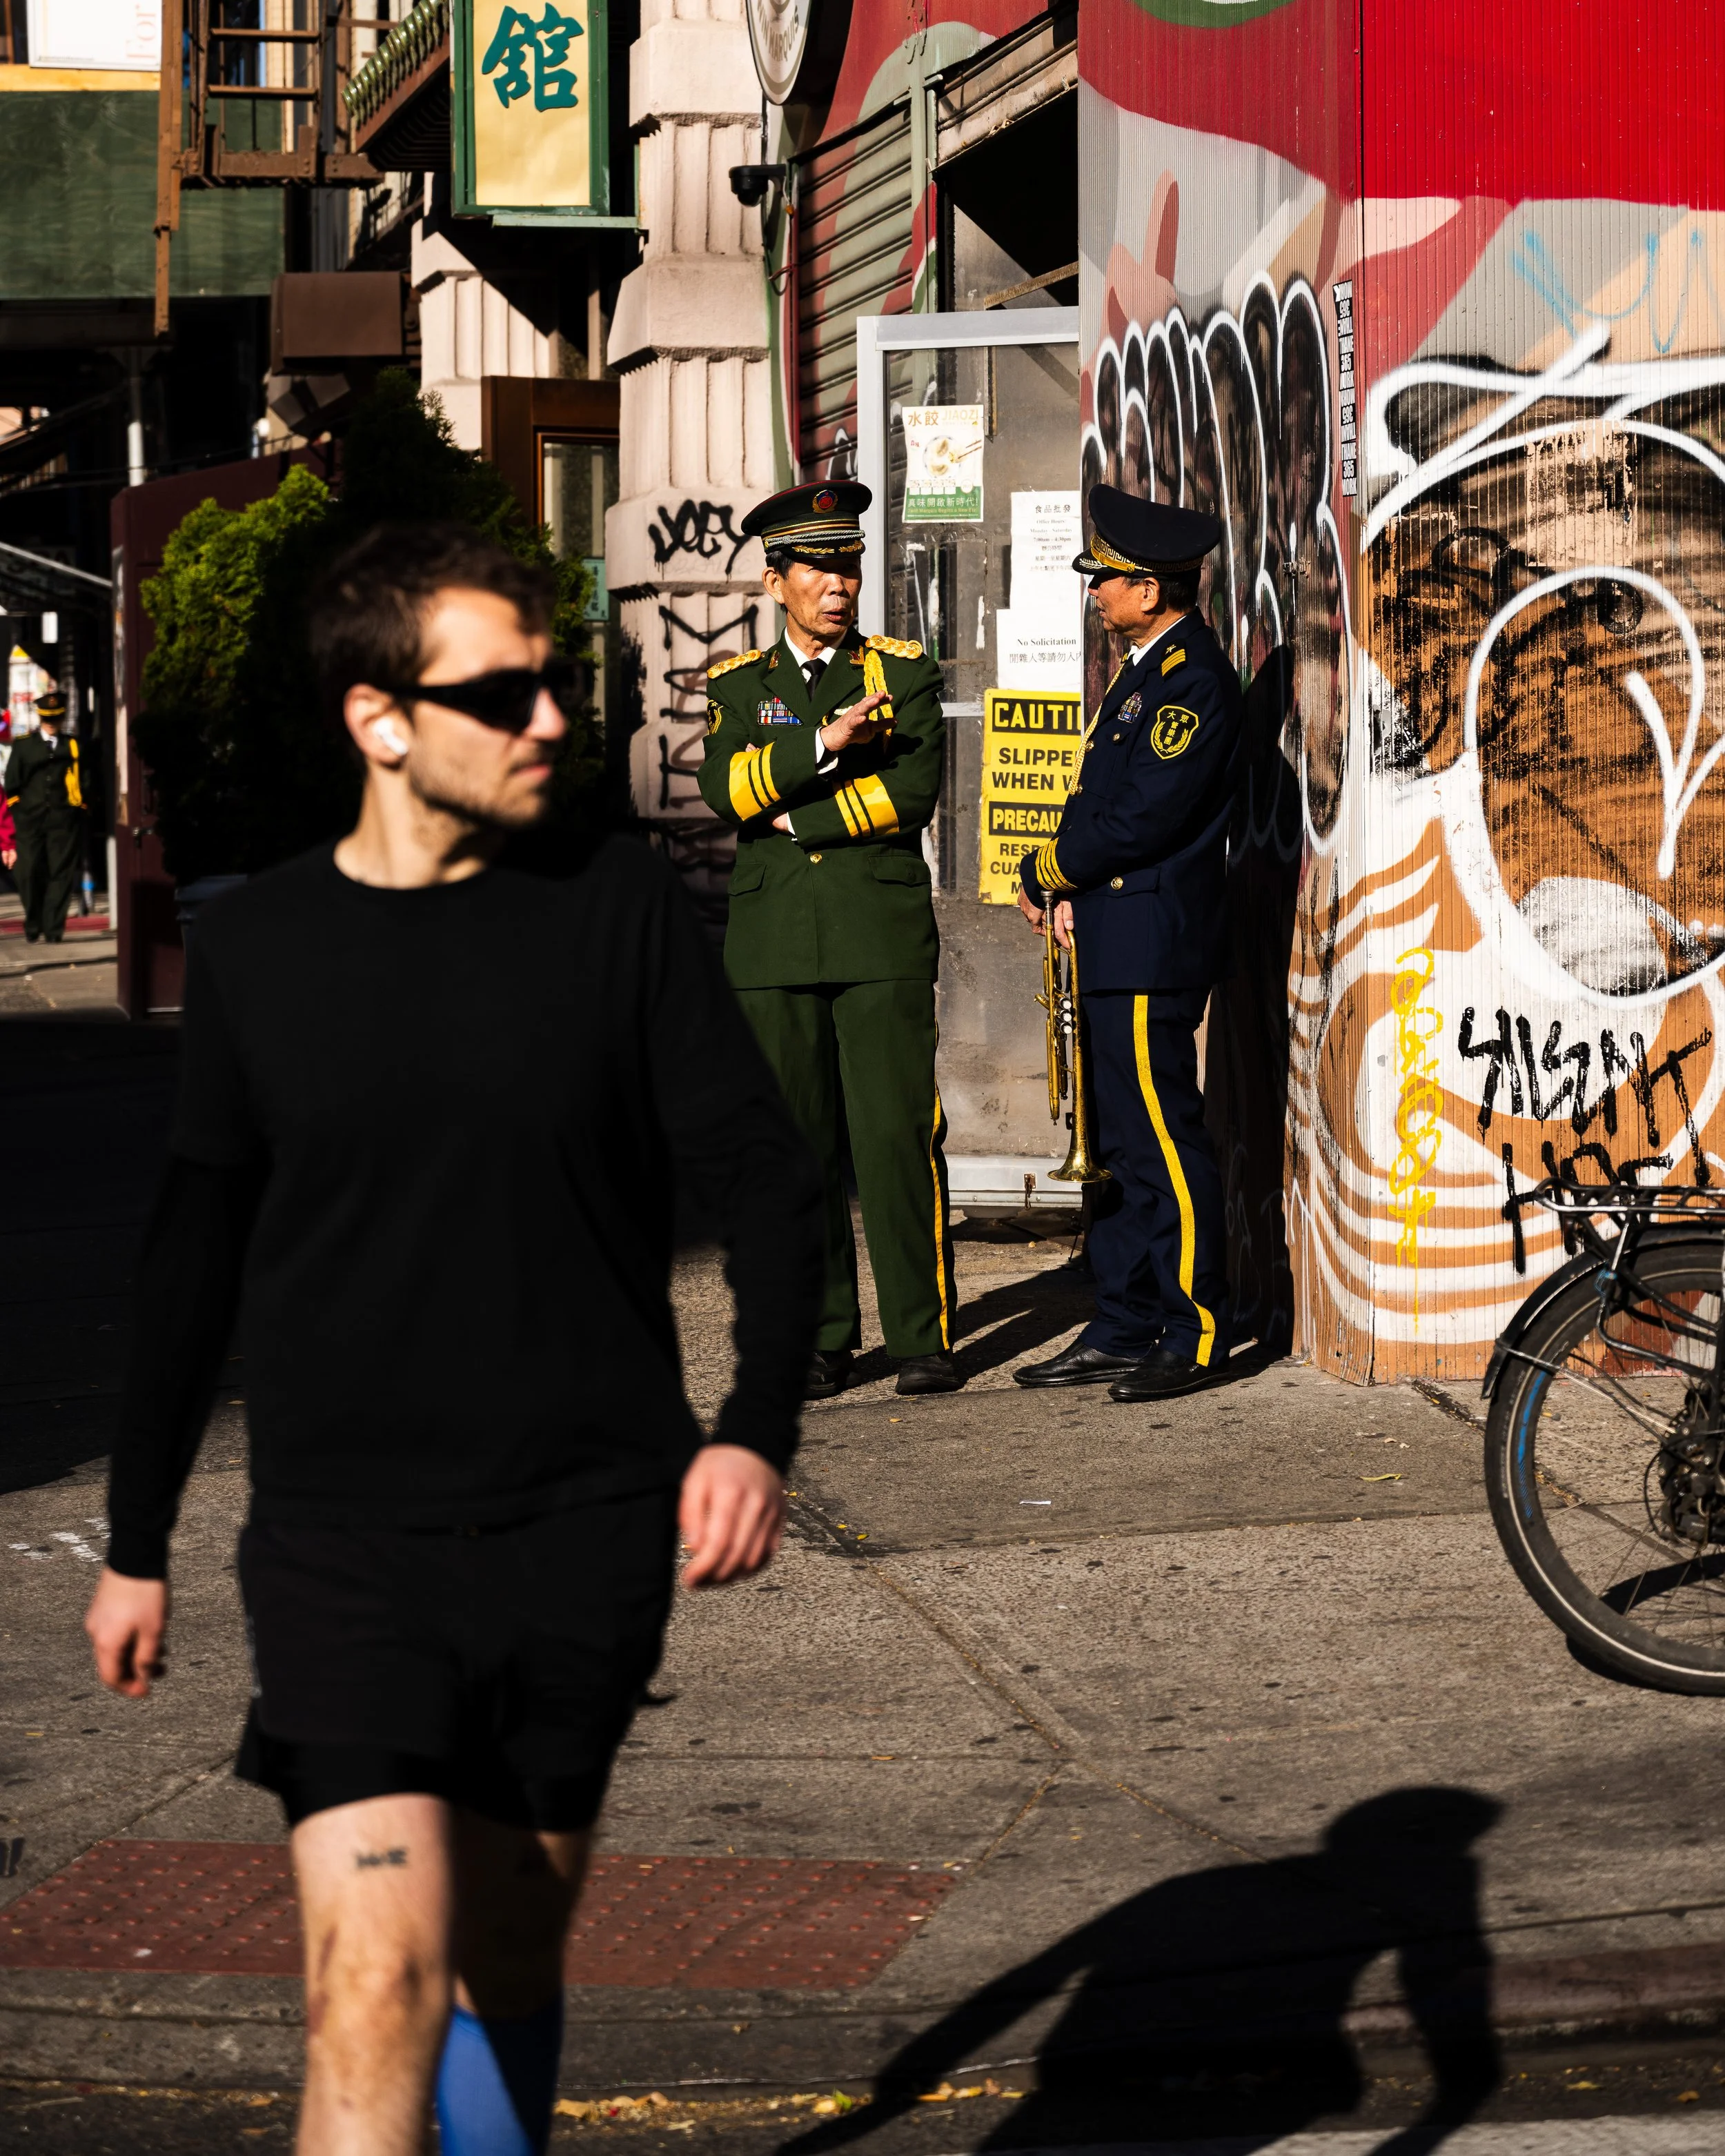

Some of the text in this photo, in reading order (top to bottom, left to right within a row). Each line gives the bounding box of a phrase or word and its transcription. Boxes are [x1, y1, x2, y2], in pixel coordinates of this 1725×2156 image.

[768, 5, 800, 61] MARQUIS
[482, 2, 584, 112] 館
[1341, 353, 1352, 372] 365
[908, 410, 939, 426] 水餃
[941, 408, 978, 421] JIAOZI
[1343, 460, 1354, 478] 365
[1035, 504, 1072, 514] 食品批發
[1031, 637, 1076, 646] Solicitation
[994, 702, 1081, 731] CAUTI
[998, 747, 1077, 767] SLIPPE
[992, 772, 1054, 791] WHEN
[992, 809, 1063, 833] PRECAU
[990, 861, 1021, 876] CUA
